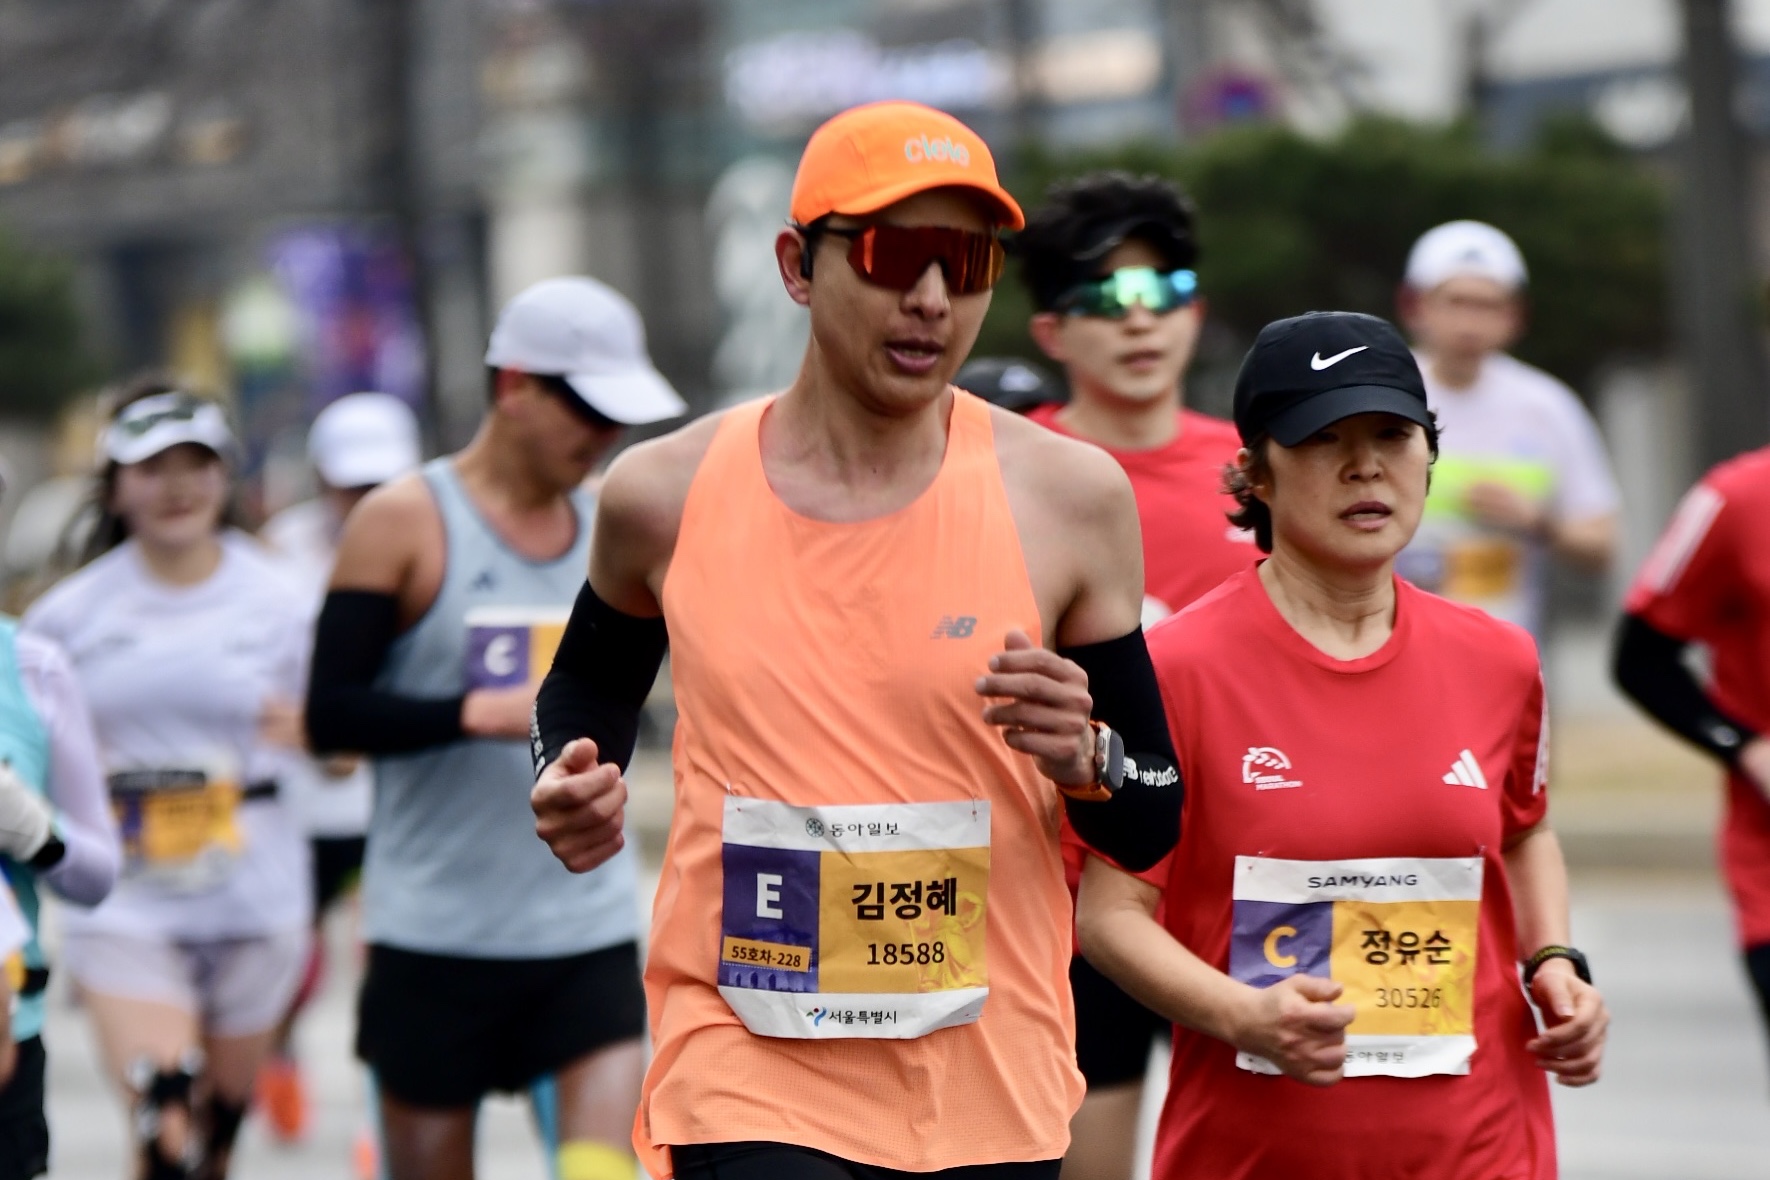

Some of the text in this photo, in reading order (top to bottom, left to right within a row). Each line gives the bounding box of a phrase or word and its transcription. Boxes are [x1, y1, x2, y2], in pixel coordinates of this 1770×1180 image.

[484, 633, 518, 677] C
[829, 822, 900, 837] 동아일보
[1307, 874, 1418, 888] SAMYANG
[756, 873, 783, 919] E
[852, 877, 957, 920] 김정혜
[731, 945, 801, 968] 55호차-228
[867, 941, 945, 966] 18588
[1263, 925, 1297, 968] C
[1360, 930, 1452, 965] 정유순
[1375, 987, 1442, 1009] 30526
[829, 1009, 897, 1025] 서울특별시
